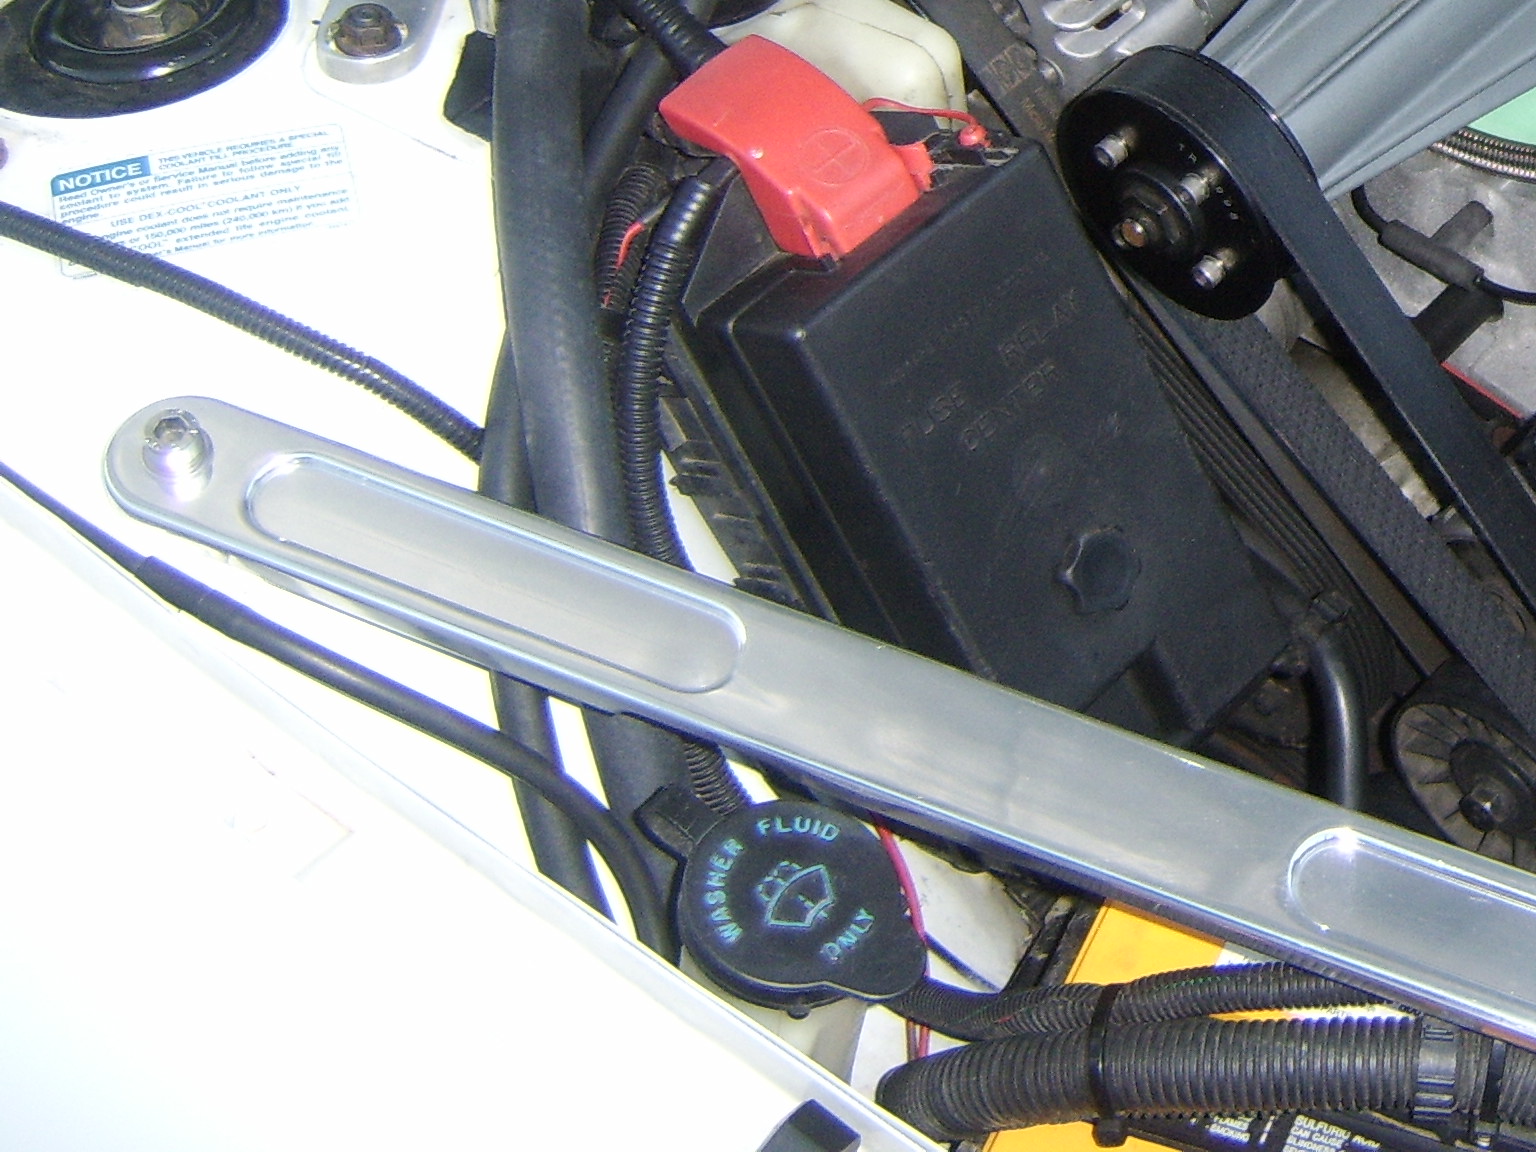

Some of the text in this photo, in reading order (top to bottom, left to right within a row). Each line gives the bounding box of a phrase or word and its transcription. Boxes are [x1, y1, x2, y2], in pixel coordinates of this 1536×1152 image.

[58, 162, 143, 191] NOTICE
[60, 200, 119, 219] procedure
[161, 183, 193, 196] result
[213, 174, 255, 187] serious
[260, 165, 305, 179] damage
[111, 216, 135, 228] USE
[207, 190, 265, 208] COOLANT
[270, 185, 301, 196] ONLY
[234, 200, 272, 214] require
[276, 188, 348, 205] maintenance
[756, 816, 841, 842] FLUID
[704, 837, 744, 945] WASHER
[820, 907, 875, 960] ONLY
